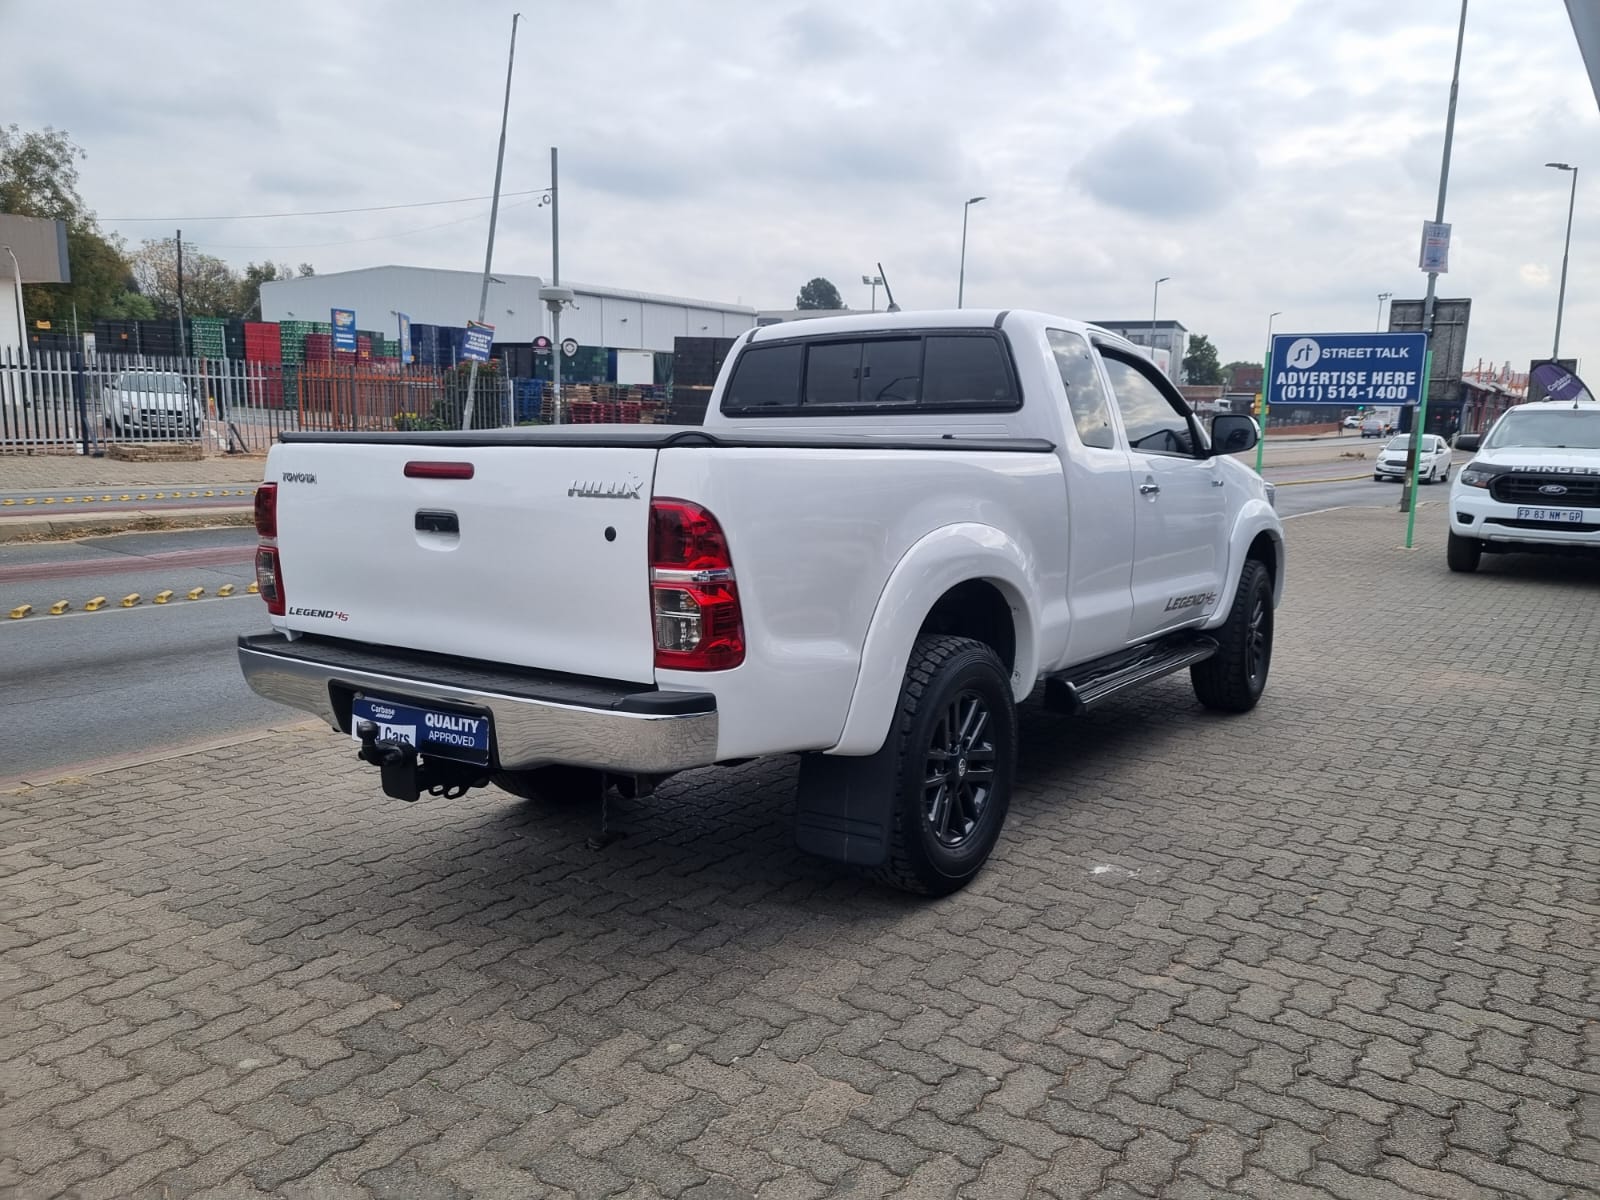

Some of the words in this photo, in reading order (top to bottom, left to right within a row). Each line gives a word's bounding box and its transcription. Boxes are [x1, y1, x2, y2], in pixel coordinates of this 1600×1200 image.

[1322, 348, 1373, 359] STREET
[1374, 347, 1409, 358] TALK
[1276, 372, 1367, 385] ADVERTISE
[1371, 372, 1416, 385] HERE
[1281, 386, 1323, 401] (011)
[1327, 386, 1408, 399] 514-1400
[282, 471, 317, 484] TOYOTA
[567, 478, 643, 500] HILUX
[1519, 509, 1530, 518] FP
[1534, 511, 1545, 520] 83
[1568, 512, 1581, 521] GP
[370, 704, 396, 716] Carbase
[424, 712, 480, 734] QUALITY
[384, 726, 410, 744] Cars
[428, 730, 475, 747] APPROVED
